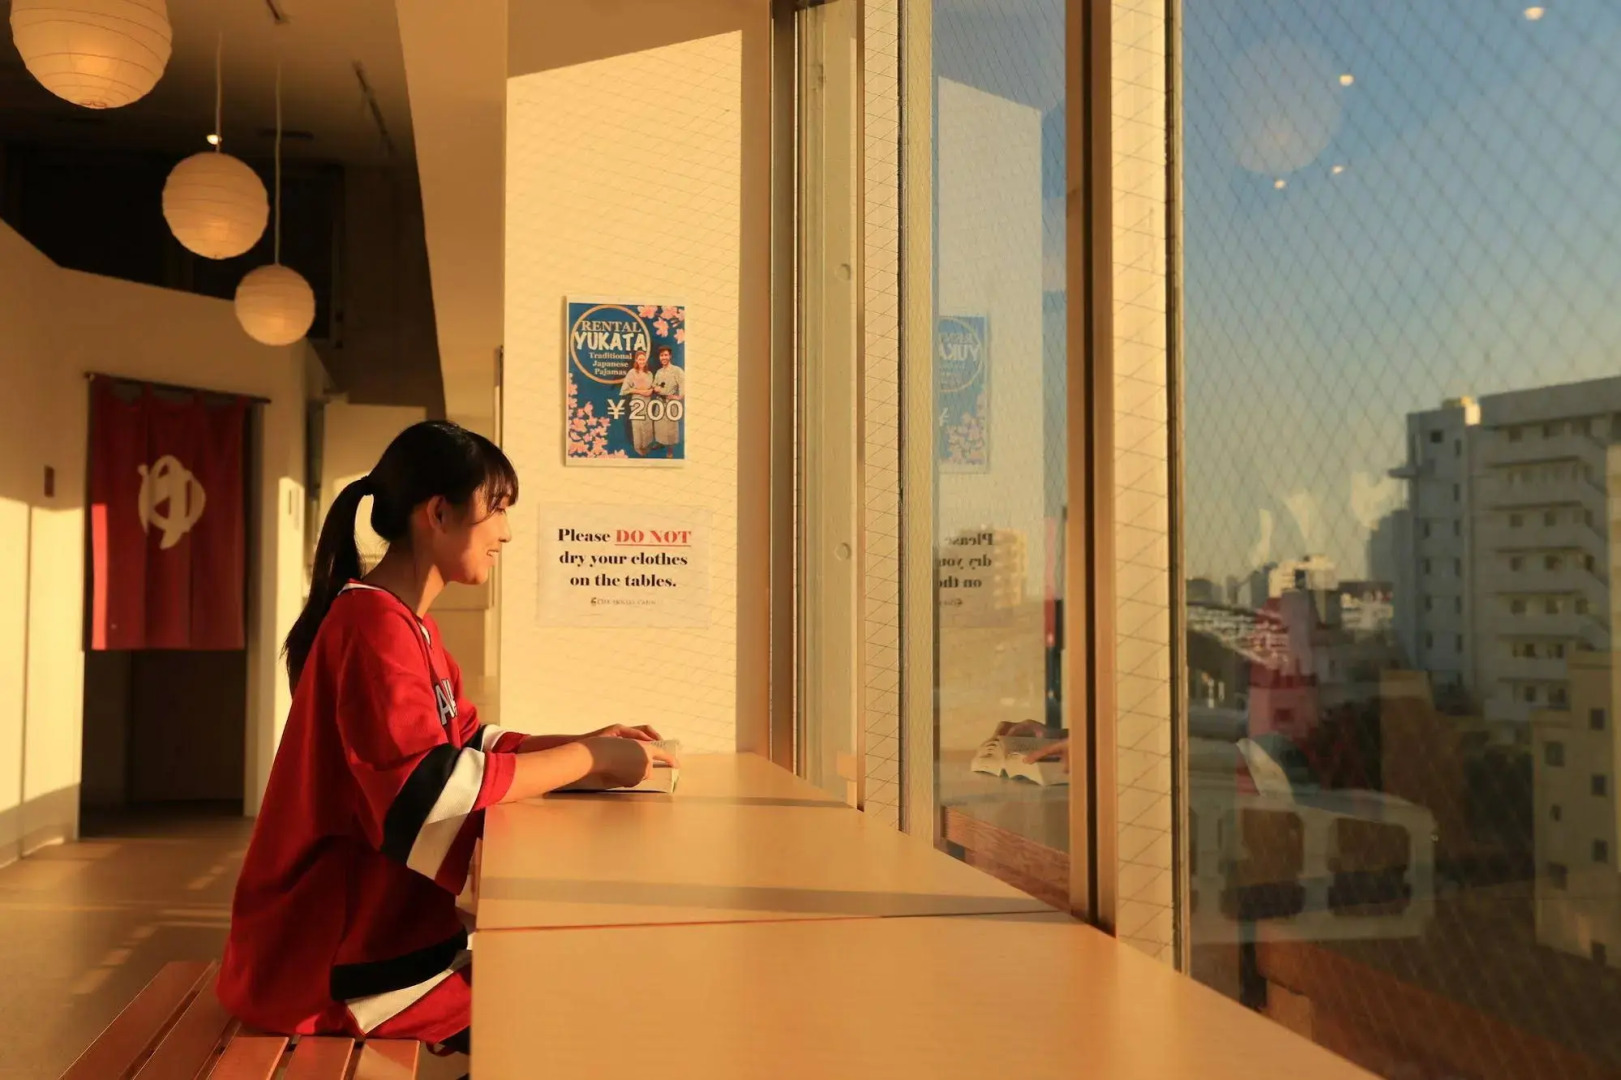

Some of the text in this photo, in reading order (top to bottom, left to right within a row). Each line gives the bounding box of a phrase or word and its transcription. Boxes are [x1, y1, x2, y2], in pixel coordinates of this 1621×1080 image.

[582, 320, 642, 333] RENTAL
[574, 331, 647, 351] YUKATA
[589, 352, 633, 360] Traditional
[592, 360, 629, 369] Japanese
[594, 368, 627, 377] Pajamas
[558, 528, 692, 544] Please DO NOT
[559, 551, 688, 568] dry your clothes
[570, 574, 677, 588] on the tables.
